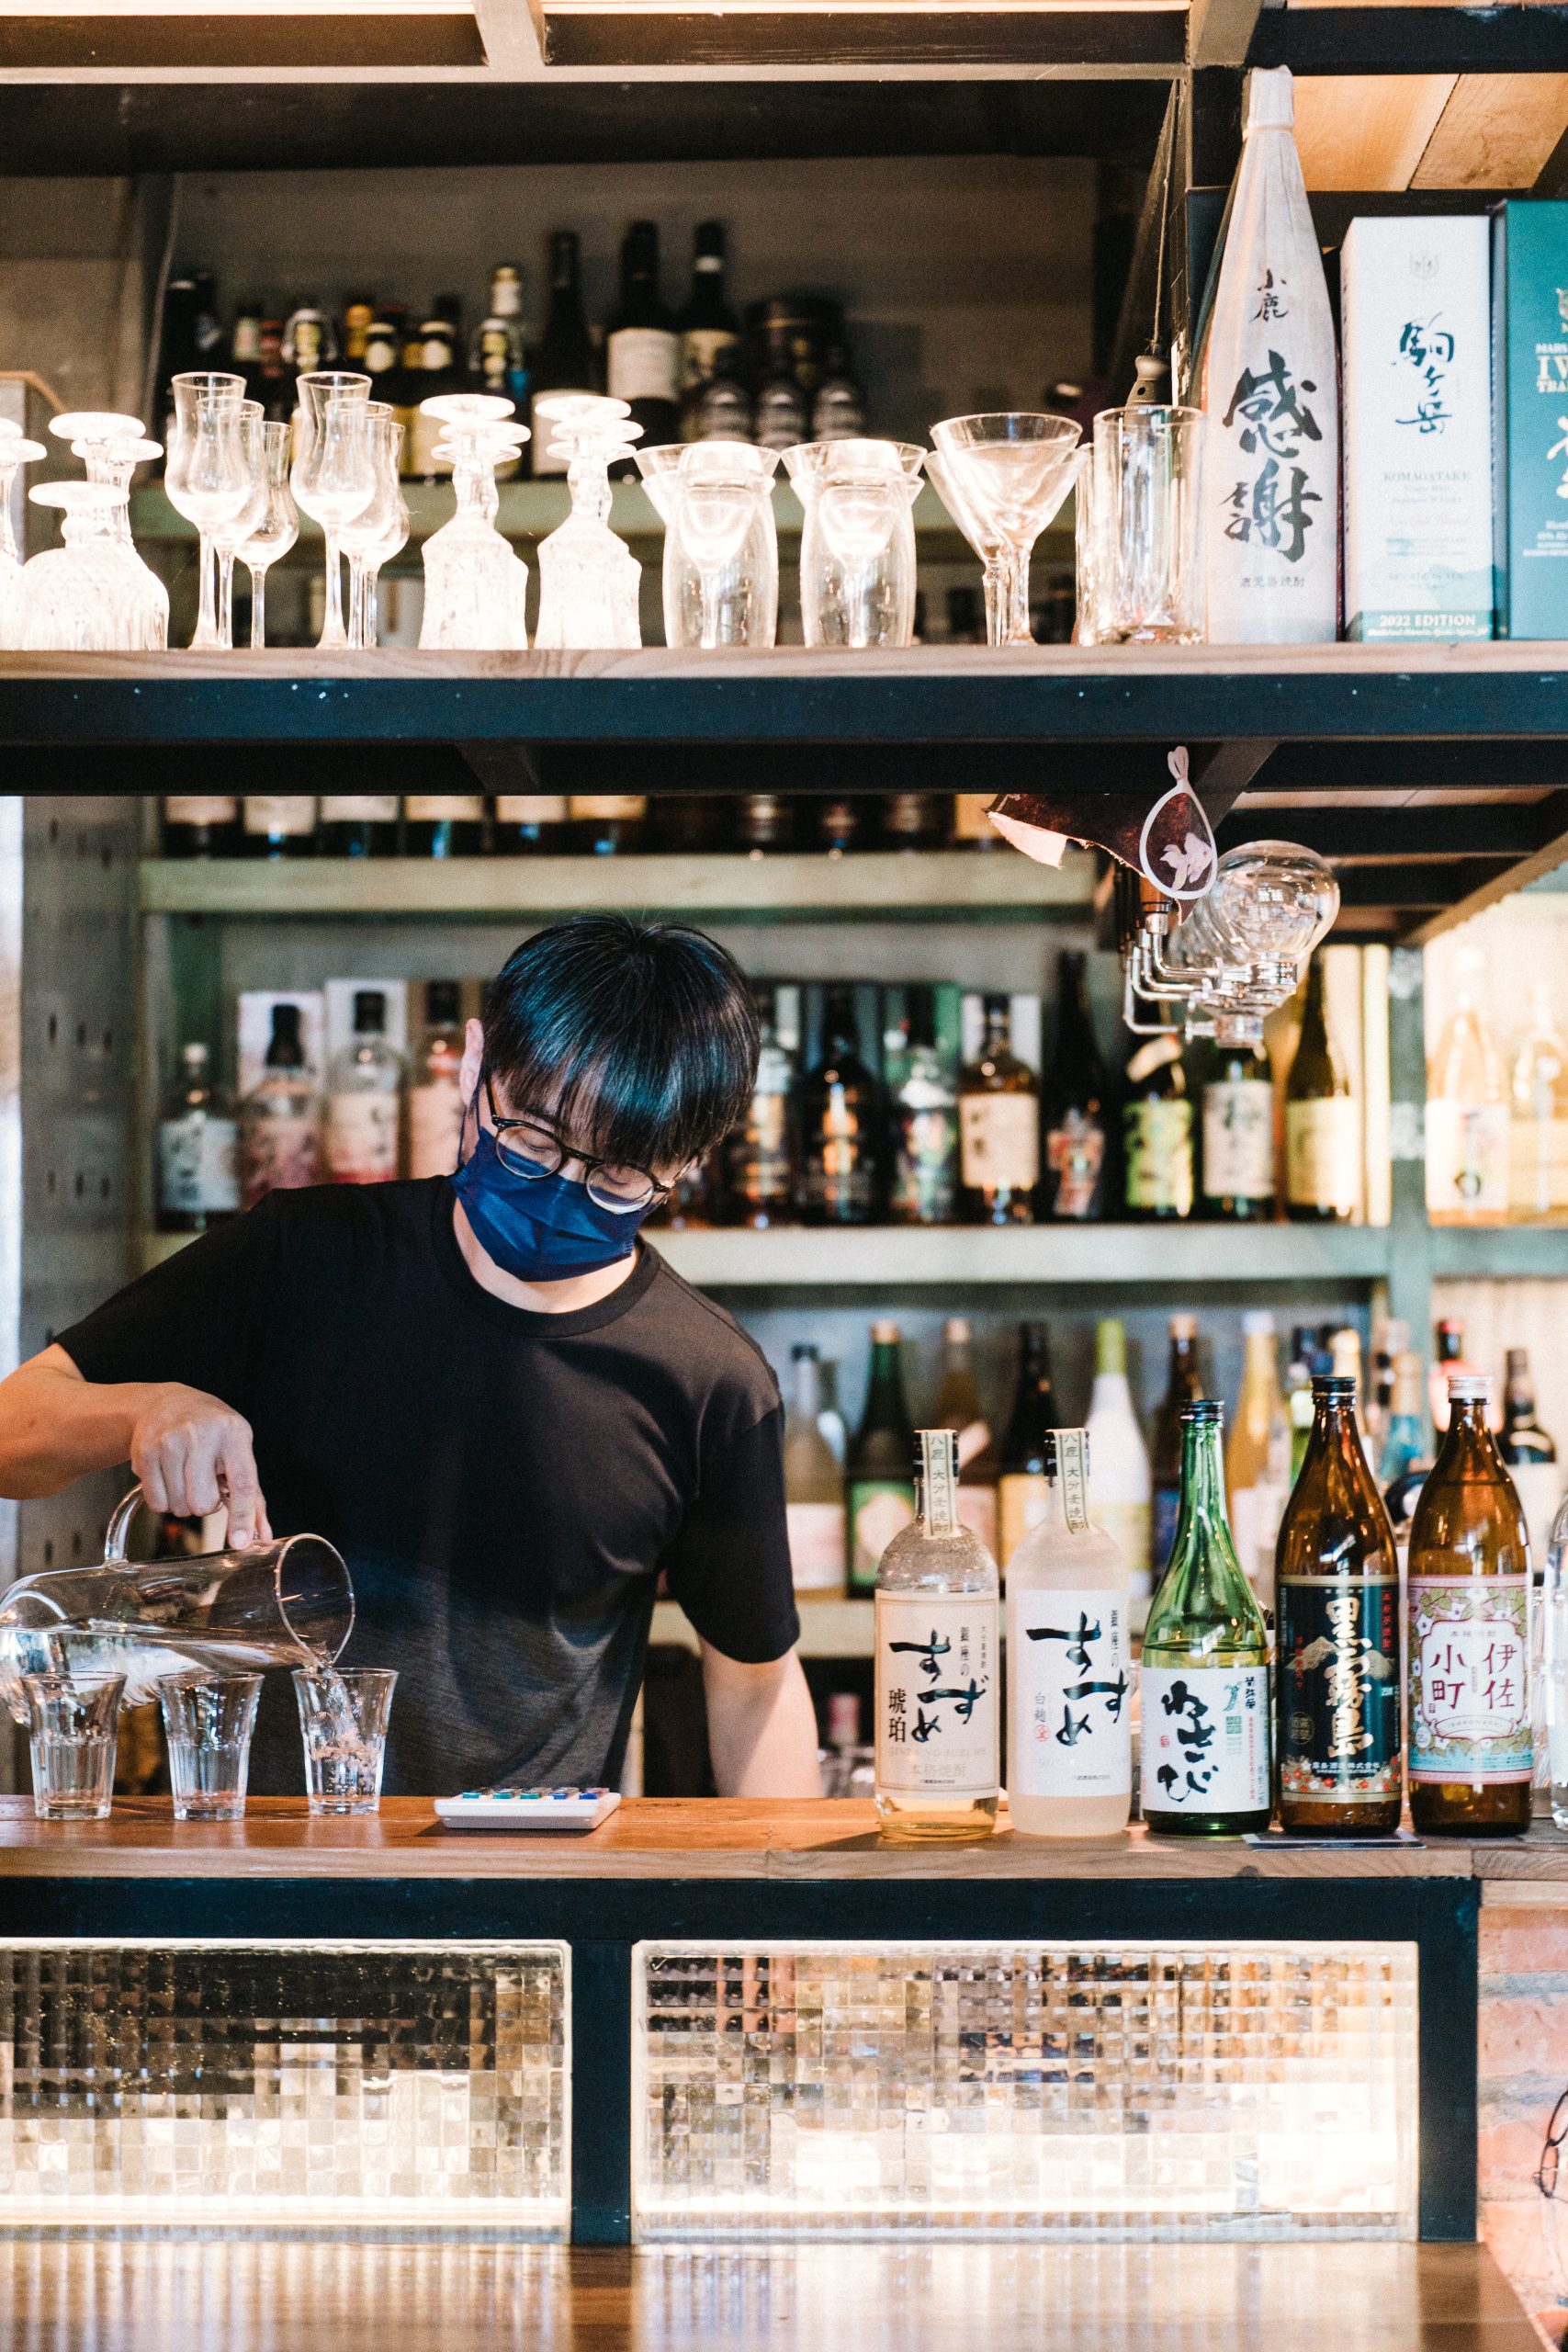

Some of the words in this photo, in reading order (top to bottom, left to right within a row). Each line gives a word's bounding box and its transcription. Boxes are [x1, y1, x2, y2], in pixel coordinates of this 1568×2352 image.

[1219, 348, 1324, 563] 感謝
[1380, 614, 1411, 627] 2022
[1415, 614, 1475, 627] EDITION
[1325, 1597, 1373, 1758] 黒霧島
[1429, 1644, 1468, 1710] 小町
[1482, 1643, 1517, 1710] 伊佐
[888, 1688, 908, 1743] 琥珀
